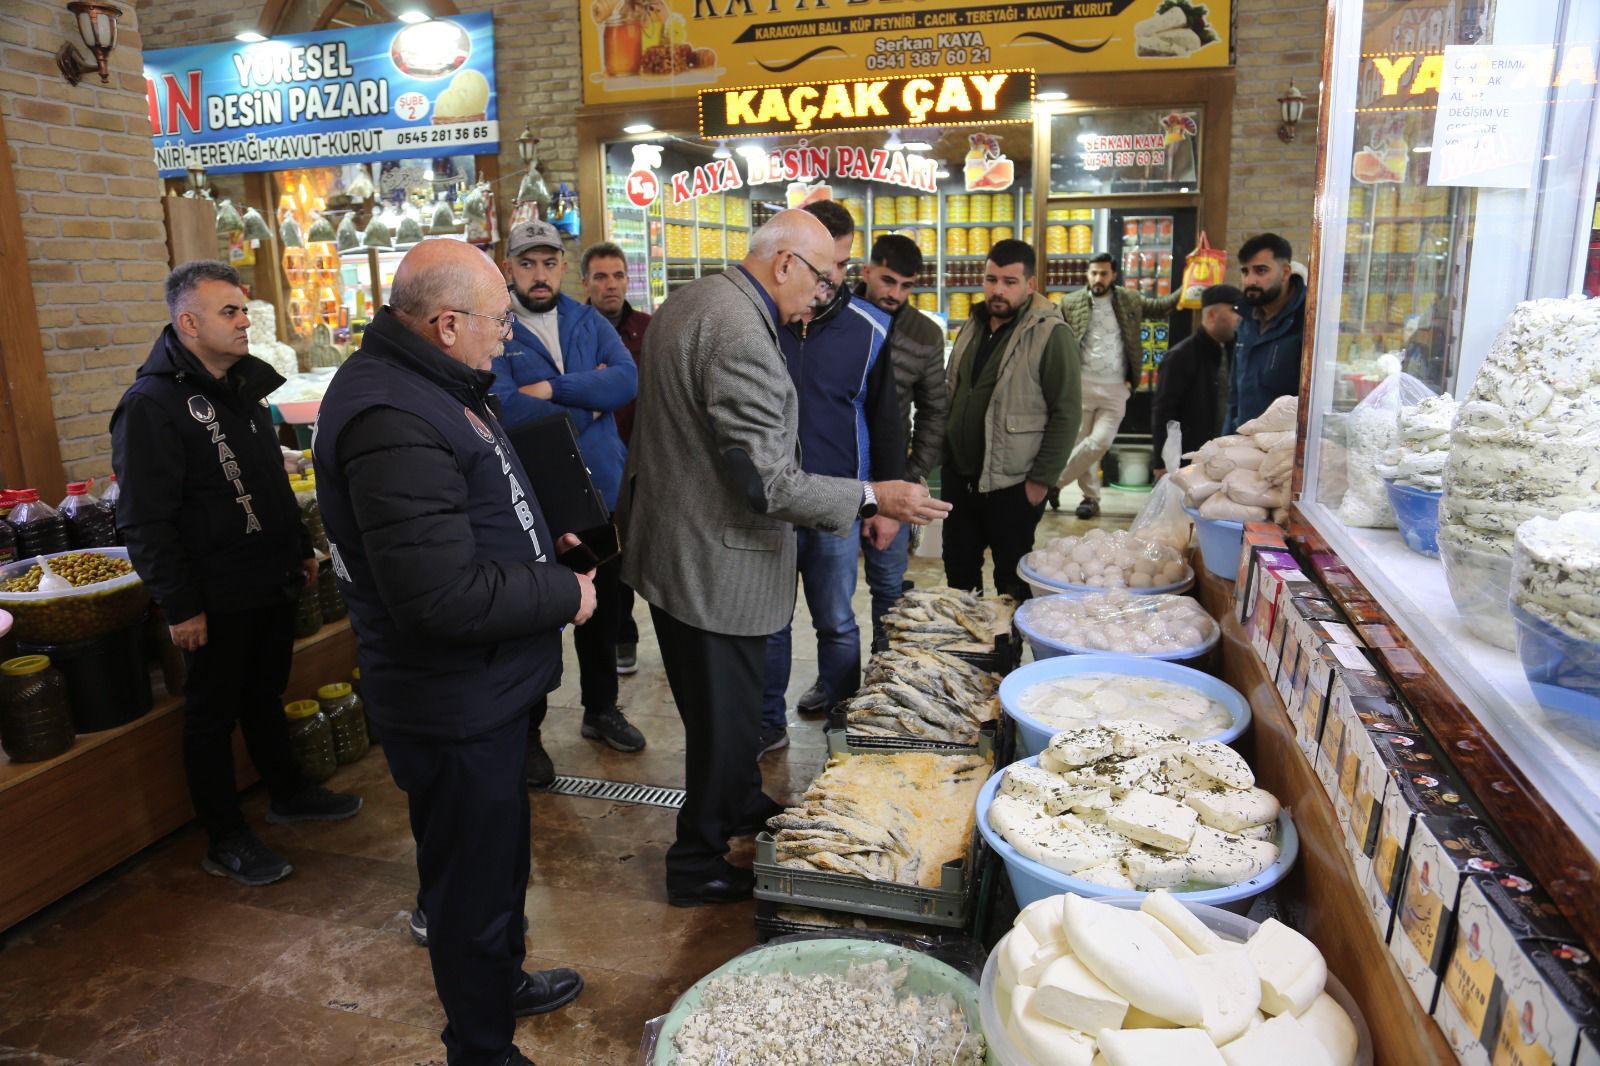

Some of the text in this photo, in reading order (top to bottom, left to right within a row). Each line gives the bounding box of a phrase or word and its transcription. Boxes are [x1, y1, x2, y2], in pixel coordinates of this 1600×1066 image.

[755, 23, 816, 41] KARAKOVAN
[819, 20, 842, 35] BALI
[850, 17, 872, 32] KÜP
[874, 14, 916, 31] PEYNİRİ
[966, 6, 1018, 24] TEREYAĞI
[1027, 5, 1065, 19] KAVUT
[1073, 2, 1113, 16] KURUT
[875, 31, 984, 52] Serkan KAYA
[866, 48, 991, 70] 0541 387 60 21
[208, 79, 389, 131] BESİN PAZARI
[399, 94, 425, 108] ŞUBE
[725, 73, 1009, 130] KAÇAK ÇAY
[408, 106, 416, 120] 2
[1448, 106, 1510, 118] DEĞİŞİM VE
[397, 126, 489, 146] 0545 281 36 65
[1086, 134, 1164, 151] SERKAN KAYA
[1116, 153, 1135, 165] 387
[1138, 152, 1151, 165] 60
[1153, 151, 1165, 164] 21
[672, 158, 743, 204] KAYA
[837, 146, 938, 192] PAZARI
[206, 422, 262, 534] ZABITA
